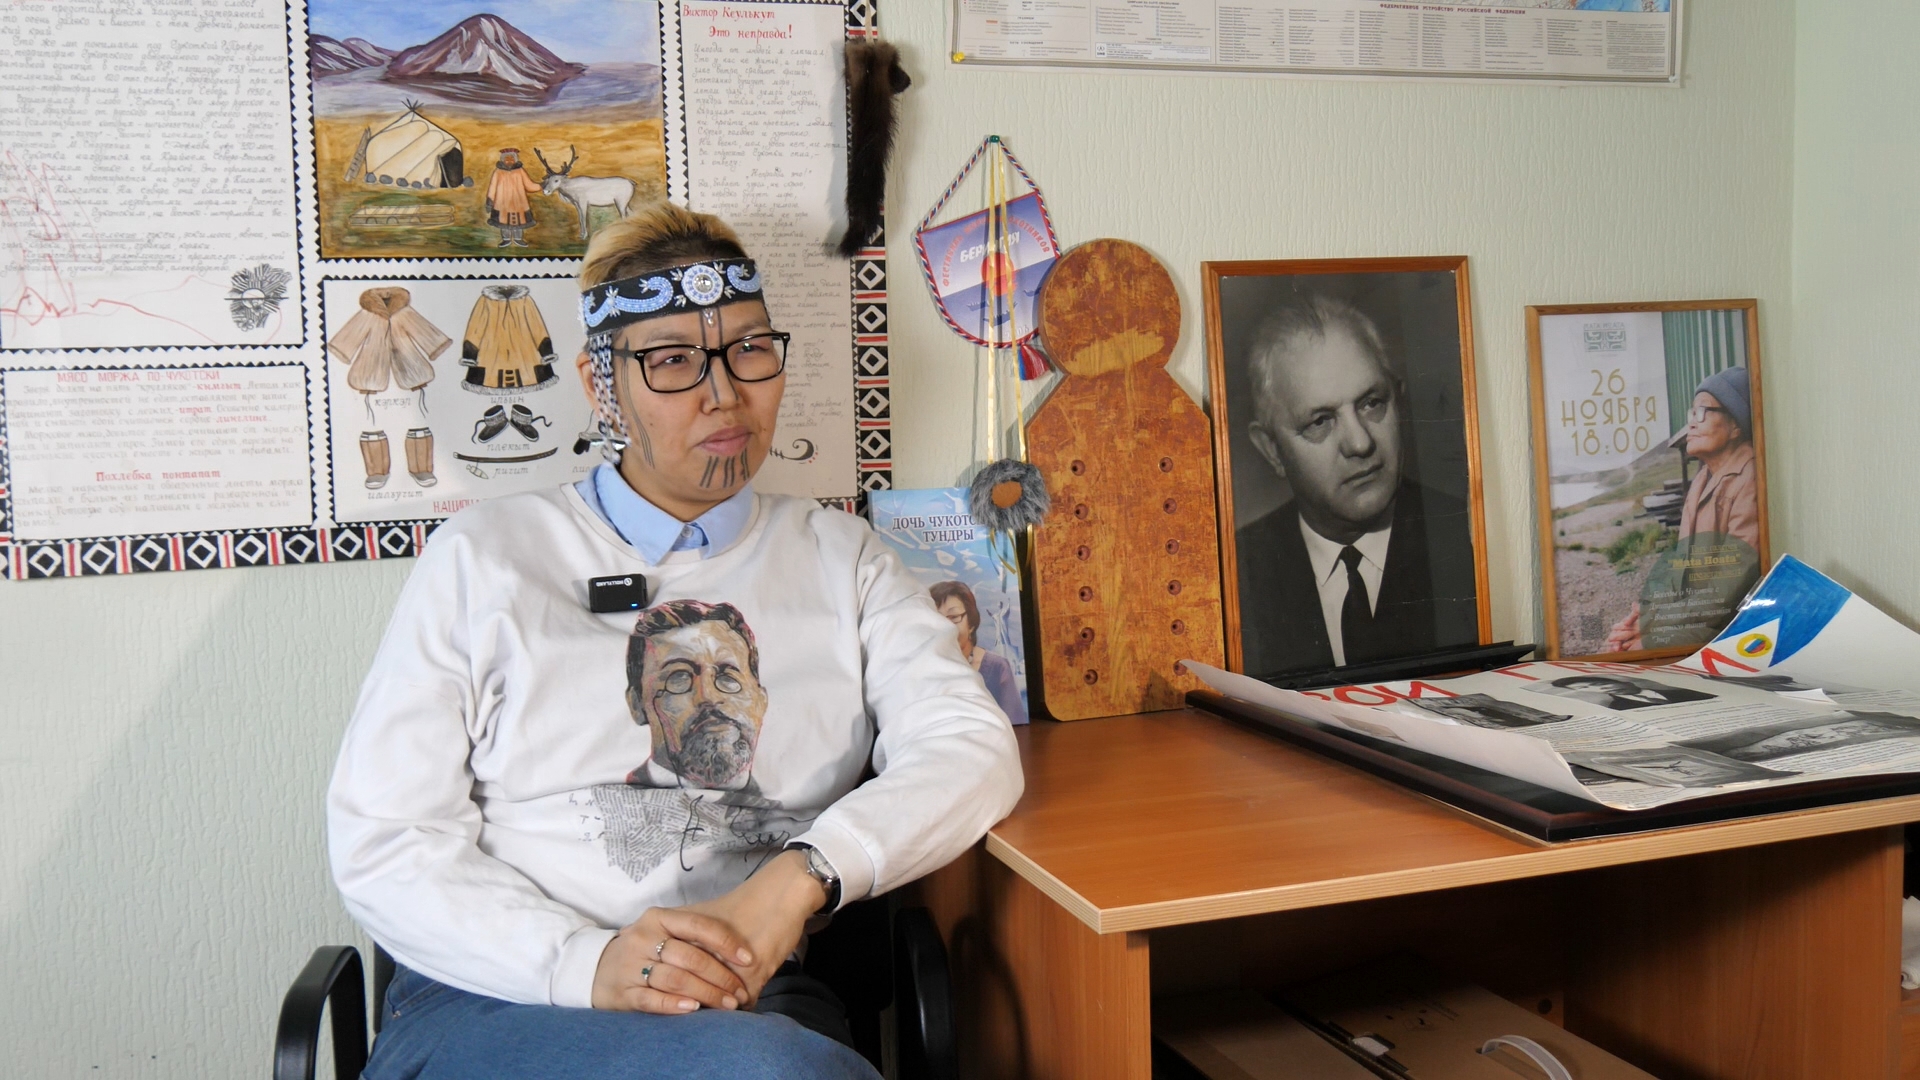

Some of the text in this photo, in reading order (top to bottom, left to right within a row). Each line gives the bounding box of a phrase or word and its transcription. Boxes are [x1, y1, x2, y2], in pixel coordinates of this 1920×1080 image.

[708, 23, 793, 45] Это неправда!
[56, 372, 88, 383] МЯСО
[97, 371, 140, 383] МОРЖА
[1590, 368, 1626, 397] 26
[1561, 395, 1657, 428] НОЯБРЯ
[1571, 424, 1650, 457] 18:00
[95, 469, 153, 482] Похлебка
[892, 514, 977, 531] ДОЧЬ ЧУКОТС
[922, 529, 975, 543] ТУНДРЫ
